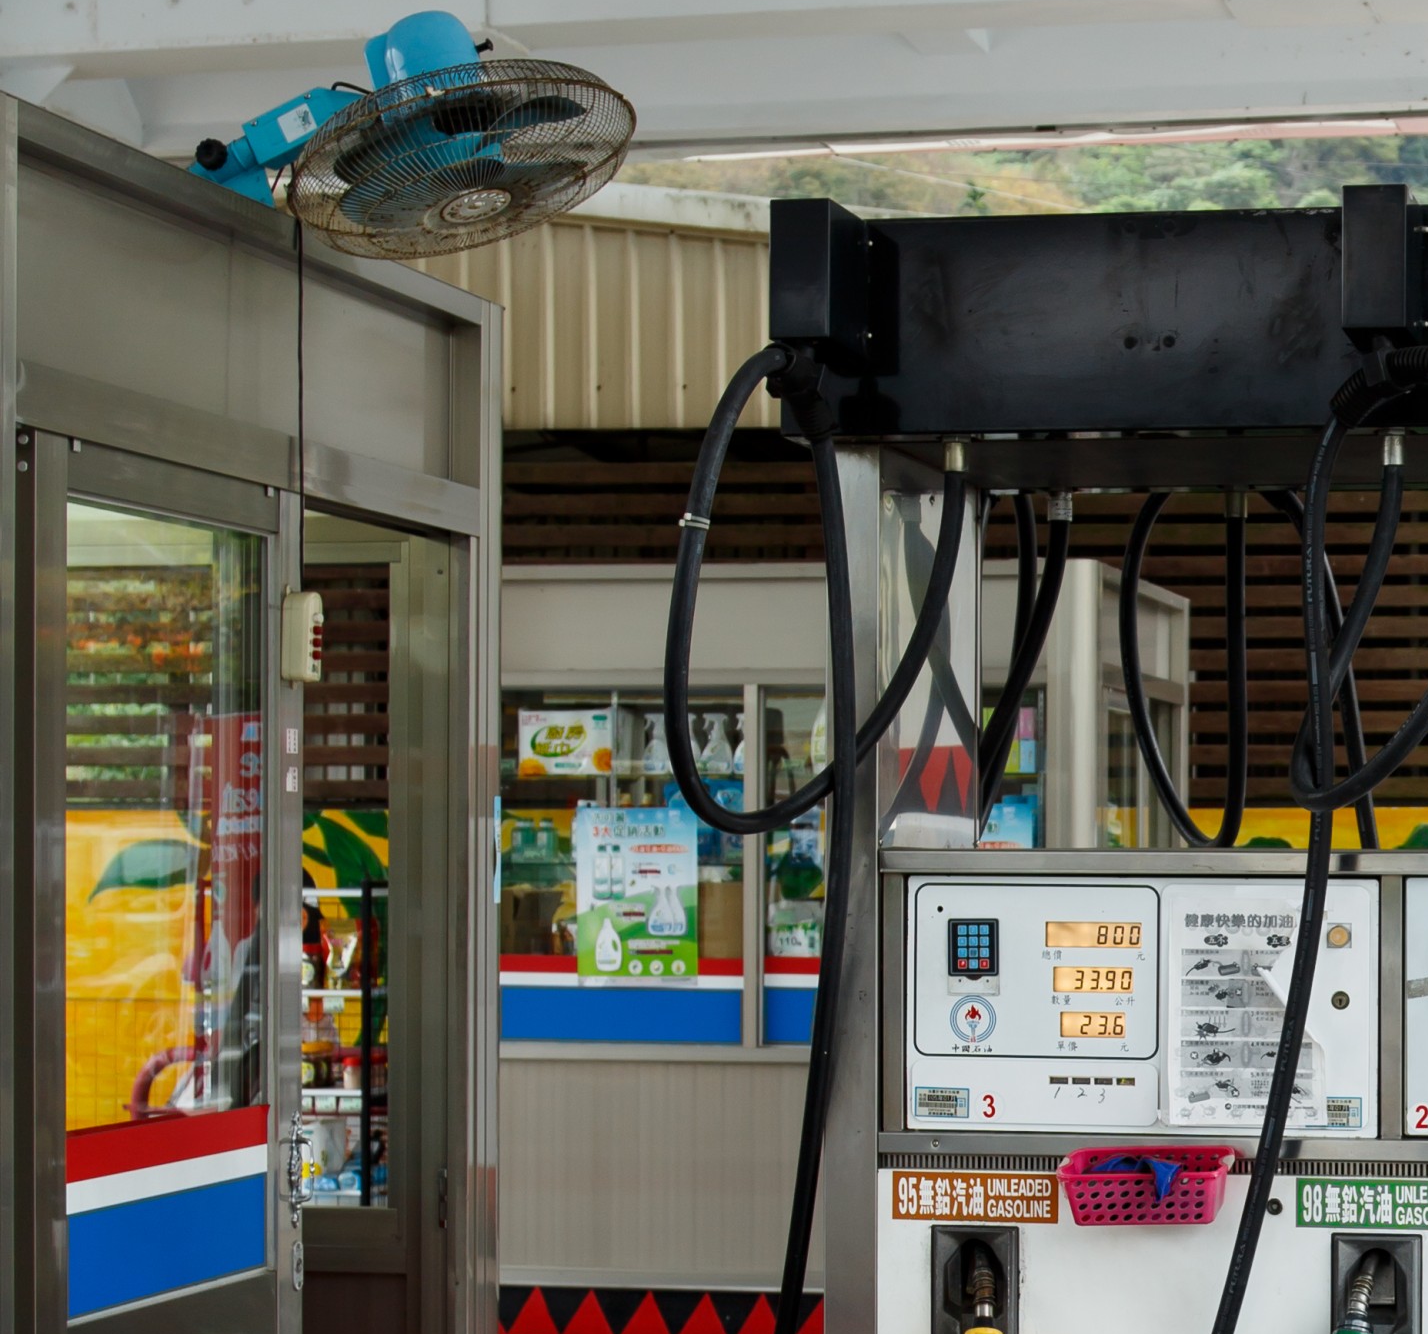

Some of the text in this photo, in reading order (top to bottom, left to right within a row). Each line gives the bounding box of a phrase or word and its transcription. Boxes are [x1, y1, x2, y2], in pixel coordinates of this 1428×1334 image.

[1096, 925, 1141, 945] 800
[1074, 970, 1133, 990] 33.90
[1080, 1015, 1124, 1036] 23.6
[982, 1094, 996, 1118] 3
[1415, 1105, 1428, 1129] 2
[898, 1175, 984, 1217] 95無鉛汽油
[987, 1178, 1051, 1197] UNLEADED
[987, 1199, 1051, 1218] GASOLINE
[1302, 1183, 1393, 1224] 98無鉛汽油
